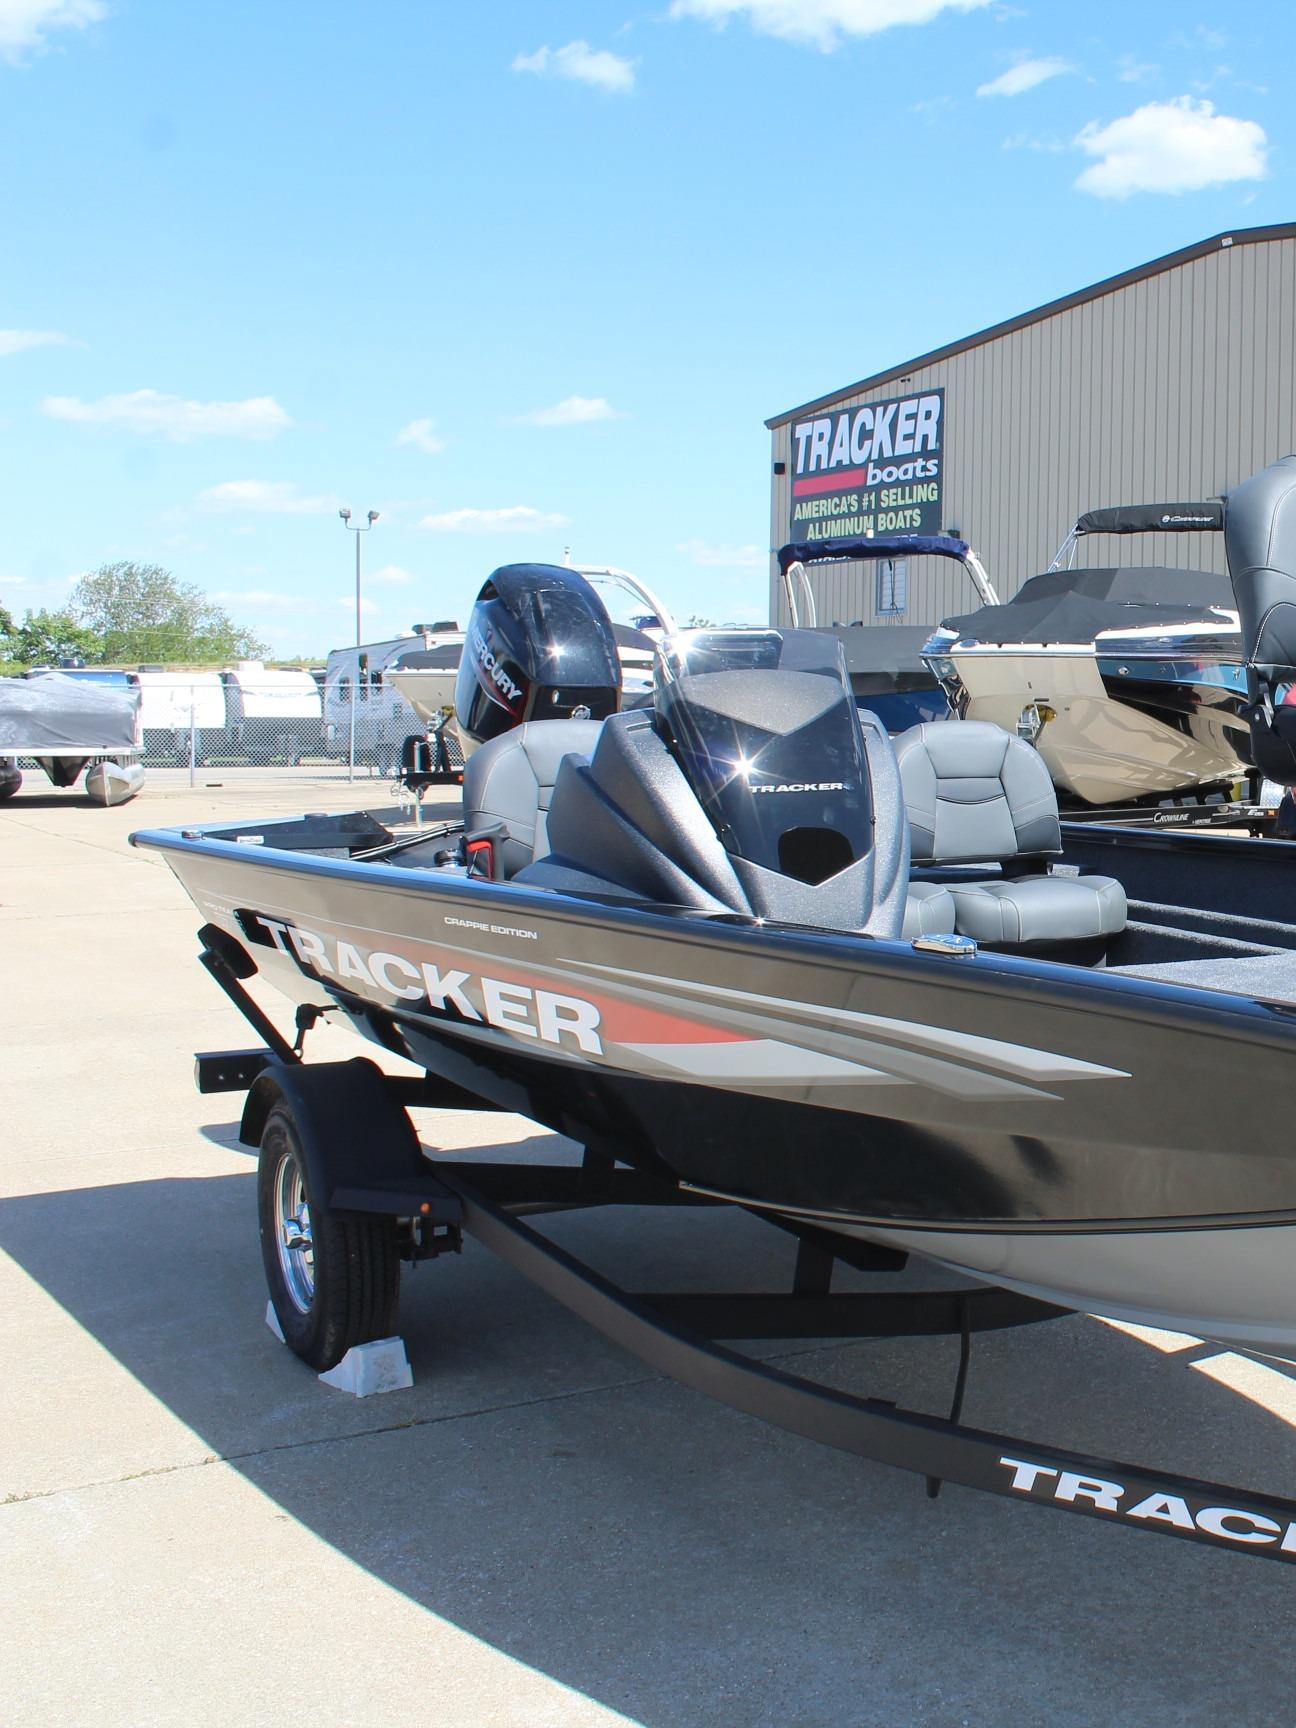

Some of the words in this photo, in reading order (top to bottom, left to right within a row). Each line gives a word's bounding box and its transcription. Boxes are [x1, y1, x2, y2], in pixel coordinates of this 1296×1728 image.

[795, 395, 941, 474] TRACKER
[866, 458, 938, 486] boats
[794, 494, 858, 521] AMERICA'S
[862, 491, 876, 511] #1
[880, 482, 938, 508] SELLING
[806, 515, 874, 541] ALUMINUM
[878, 508, 921, 532] BOATS
[748, 782, 844, 793] TRACKER
[444, 916, 490, 932] CRAPPIE
[490, 924, 538, 940] EDITION
[256, 916, 604, 1056] TRACKER
